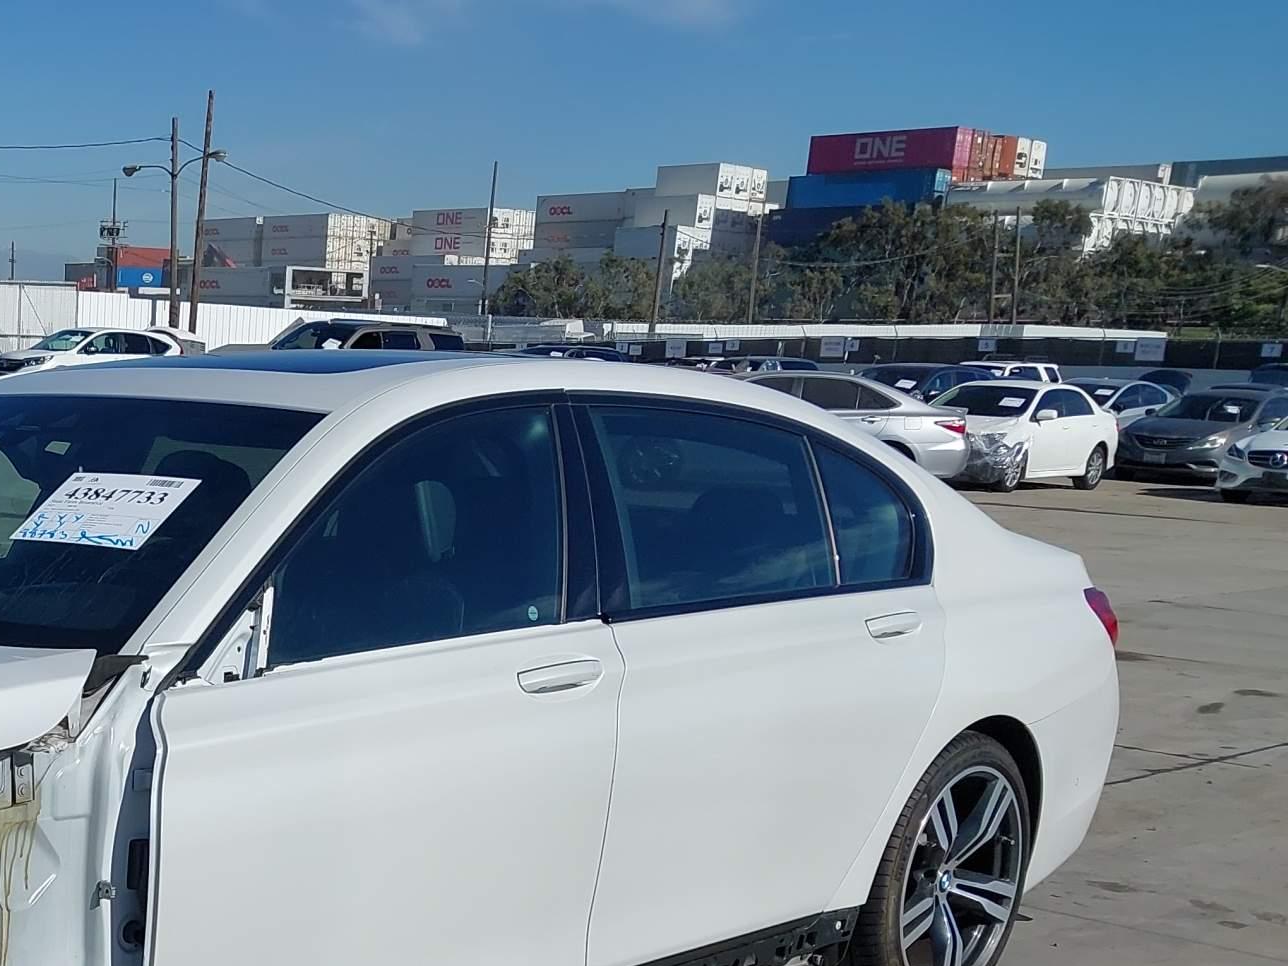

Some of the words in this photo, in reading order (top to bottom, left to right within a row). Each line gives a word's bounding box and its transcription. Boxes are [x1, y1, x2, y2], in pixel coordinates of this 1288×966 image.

[854, 136, 907, 159] ONE
[437, 212, 462, 225] ONE
[434, 237, 461, 250] ONE
[427, 278, 452, 289] OOCL
[64, 487, 169, 506] 43847733
